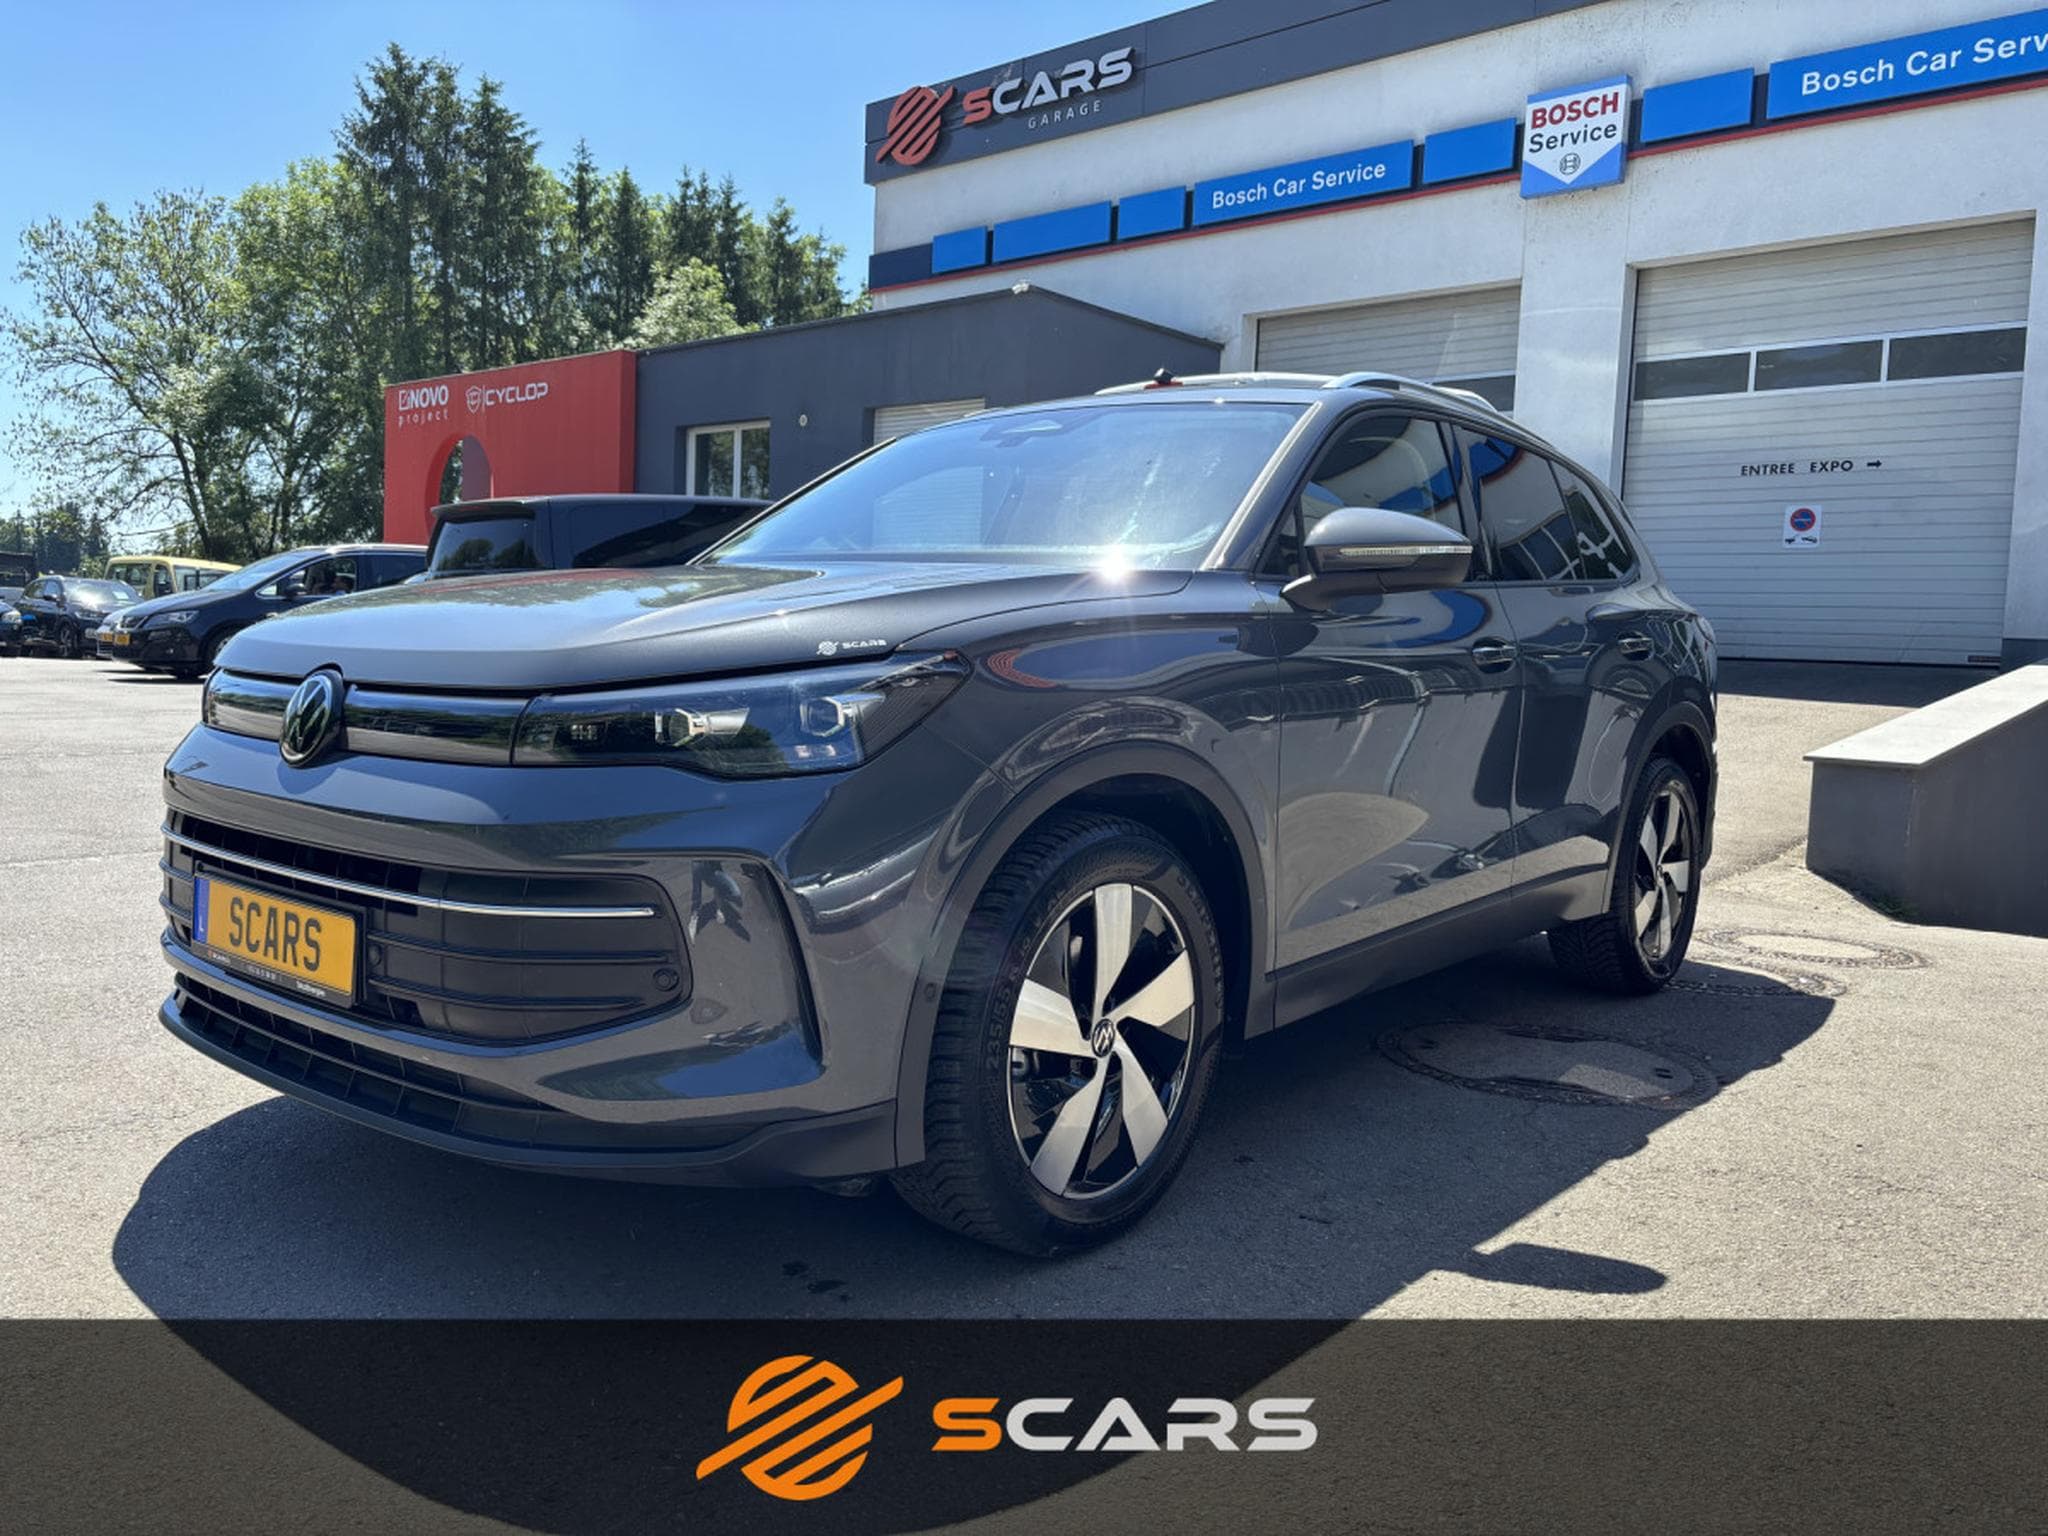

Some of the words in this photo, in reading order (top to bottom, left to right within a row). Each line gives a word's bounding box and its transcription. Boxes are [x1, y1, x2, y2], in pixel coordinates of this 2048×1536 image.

[1802, 59, 1894, 96] Bosch
[1906, 49, 1962, 76] Car
[1972, 33, 2048, 63] Serv
[962, 47, 1133, 125] SCARS
[1028, 102, 1101, 129] GARAGE
[1531, 92, 1619, 129] BOSCH
[1529, 124, 1617, 153] Service
[1212, 183, 1267, 209] Bosch
[1273, 178, 1305, 197] Car
[1311, 163, 1386, 190] Service
[485, 382, 549, 406] CYCLOP
[399, 409, 448, 428] project
[1741, 463, 1795, 476] ENTREE
[1810, 460, 1854, 473] EXPO
[229, 896, 322, 972] SCARS
